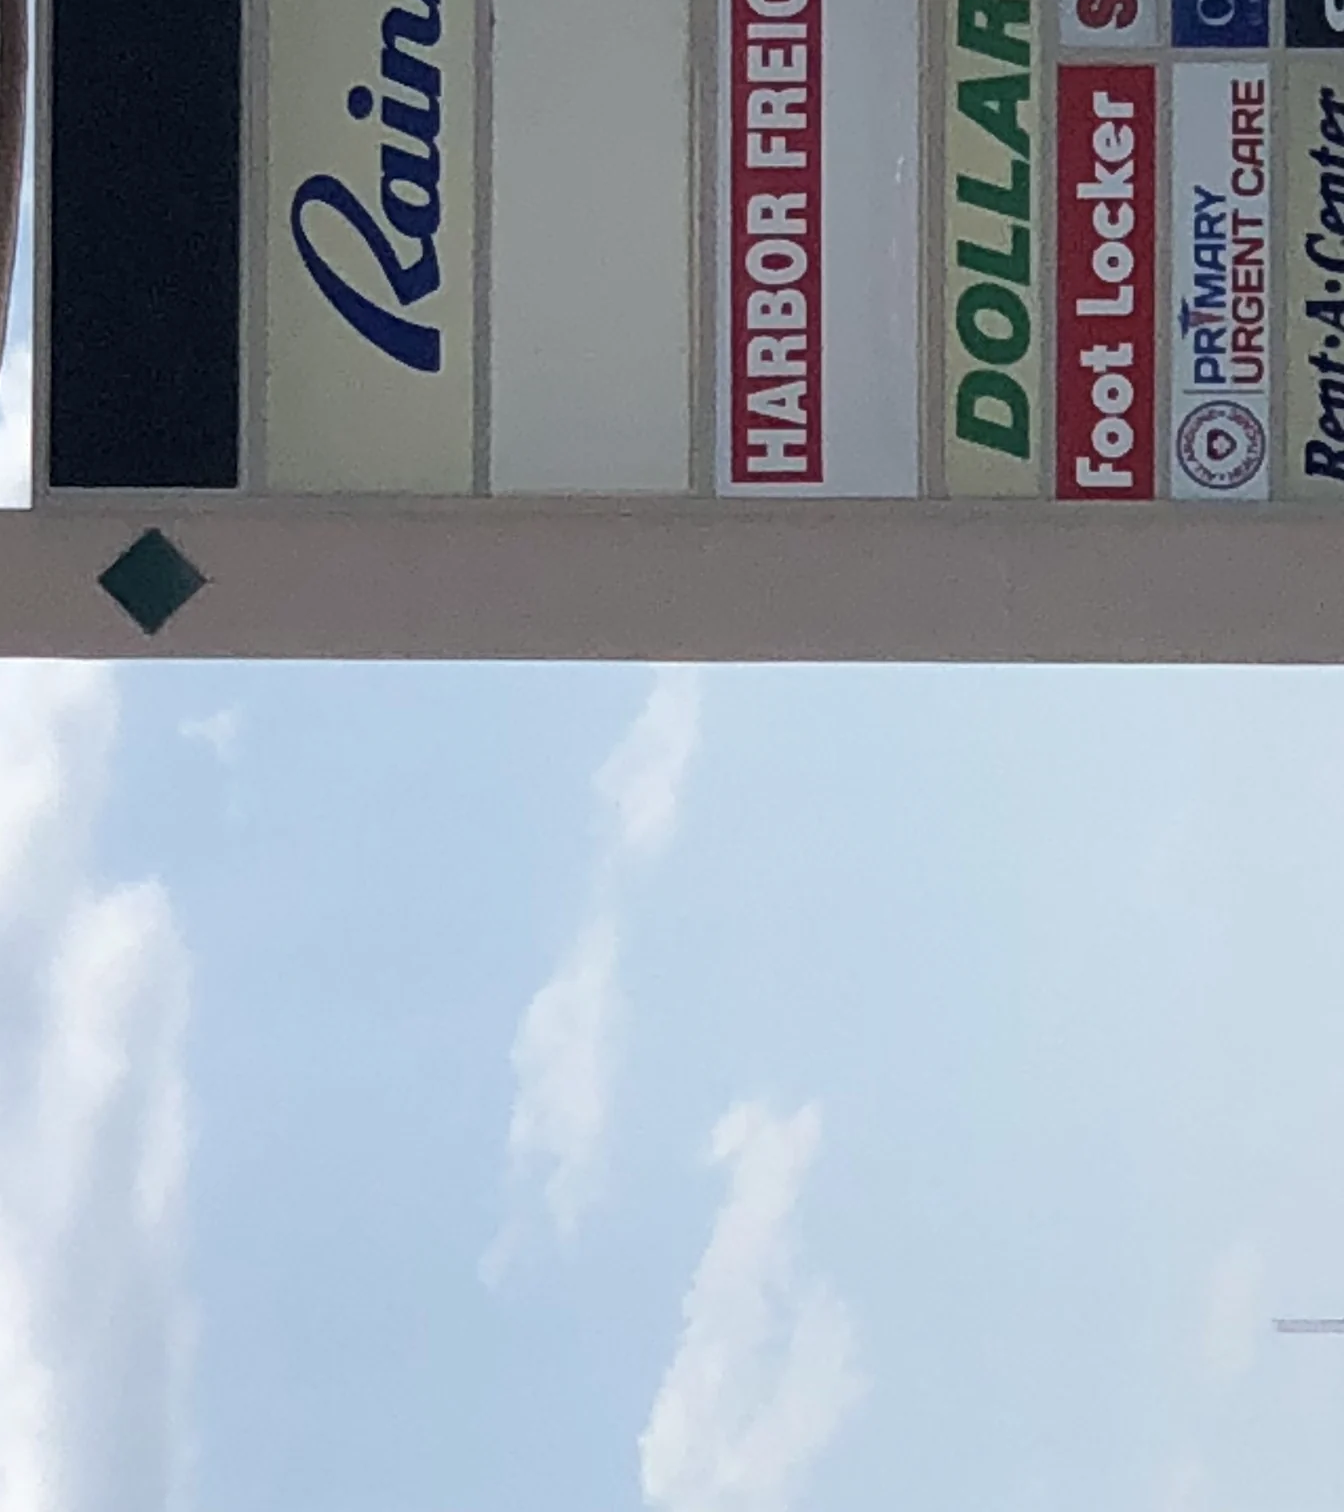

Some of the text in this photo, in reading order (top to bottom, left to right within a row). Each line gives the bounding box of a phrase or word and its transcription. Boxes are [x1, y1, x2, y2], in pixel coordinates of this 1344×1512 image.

[746, 191, 809, 472] HARBOR
[1076, 91, 1135, 488] Foot Locker
[1178, 185, 1227, 384] PRIMARY
[1232, 79, 1265, 384] URGENT CARE
